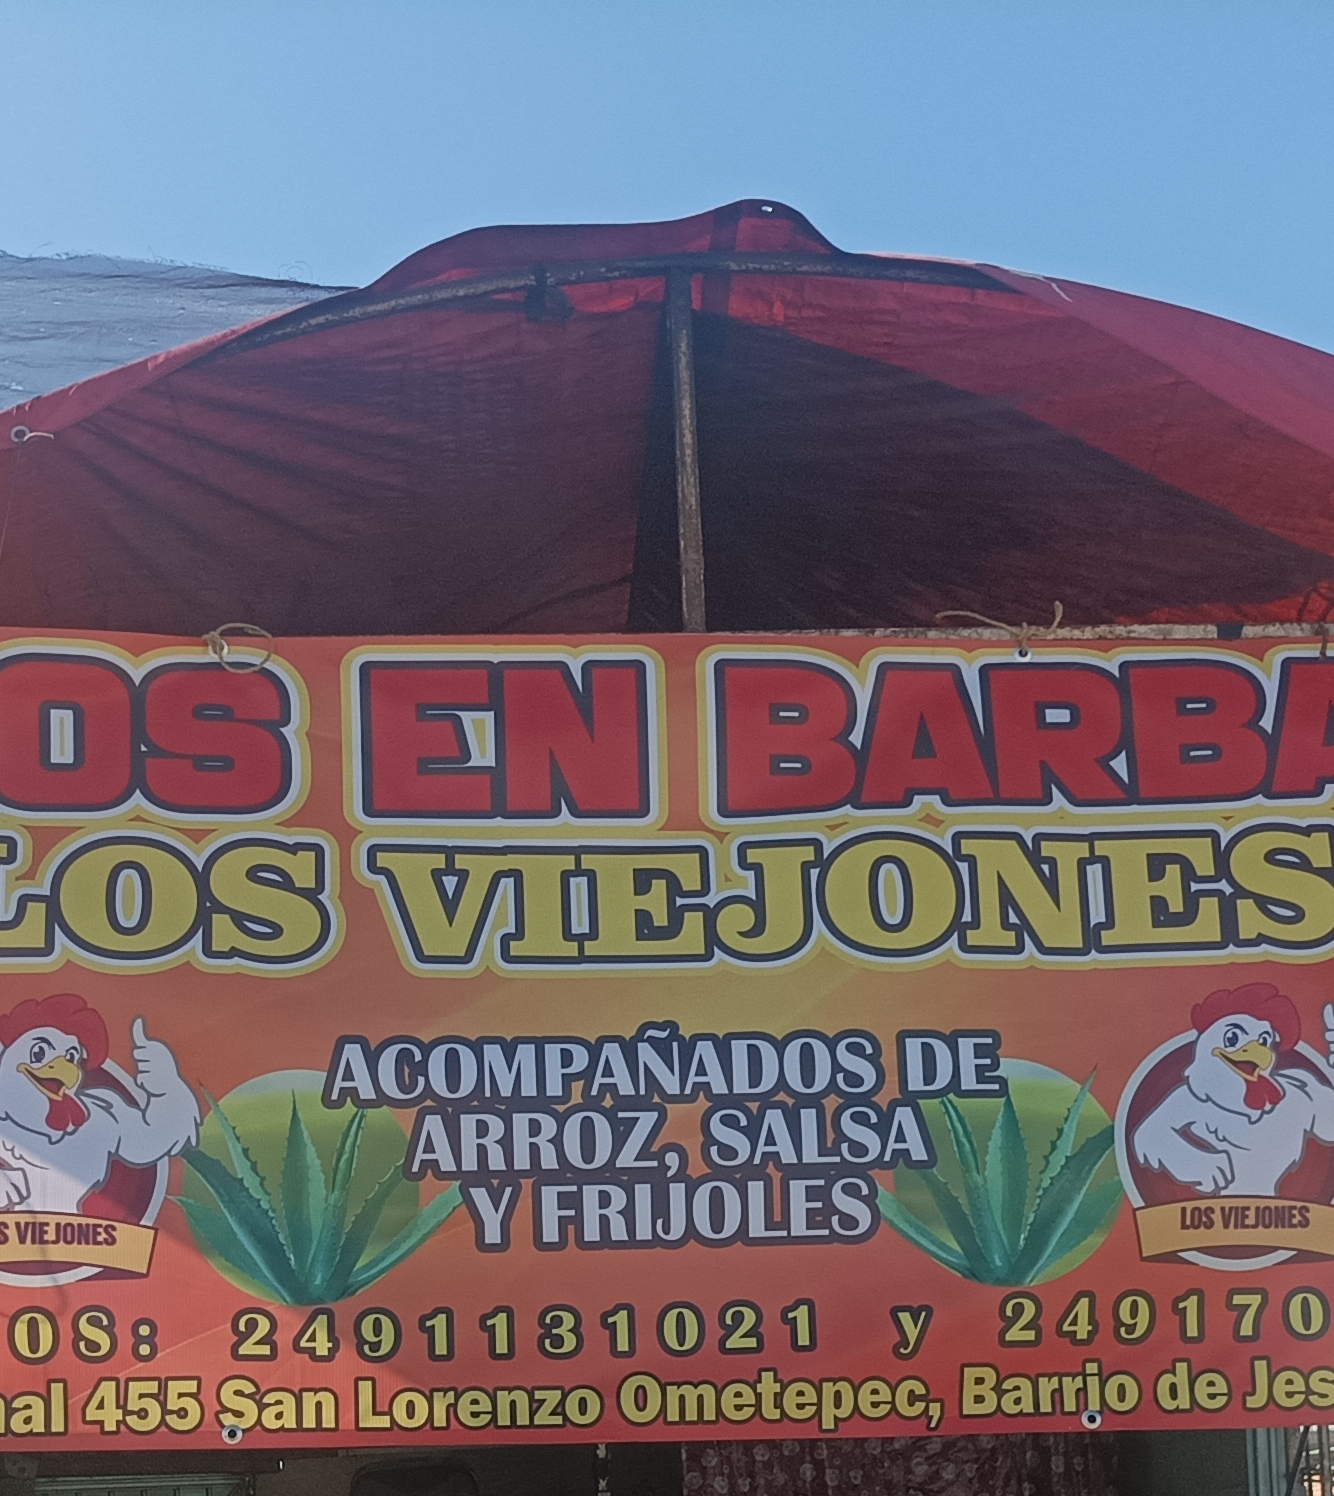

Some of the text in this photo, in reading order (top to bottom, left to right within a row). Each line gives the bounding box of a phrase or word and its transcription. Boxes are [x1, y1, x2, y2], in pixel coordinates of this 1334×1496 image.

[360, 659, 650, 819] EN
[330, 1025, 1003, 1100] ACOMPAÑADOS DE
[411, 1105, 929, 1178] ARROZ, SALSA
[17, 1221, 116, 1248] VIEJONES
[469, 1178, 871, 1245] Y FRIJOLES
[1180, 1205, 1310, 1231] LOS VIEJONES
[237, 1302, 815, 1362] 2491131021
[898, 1308, 928, 1352] y
[84, 1380, 202, 1433] 455
[219, 1379, 336, 1432] San
[358, 1379, 601, 1430] Lorenzo
[618, 1369, 942, 1430] Ometepec,
[961, 1362, 1139, 1416] Barrio
[1157, 1360, 1228, 1411] de
